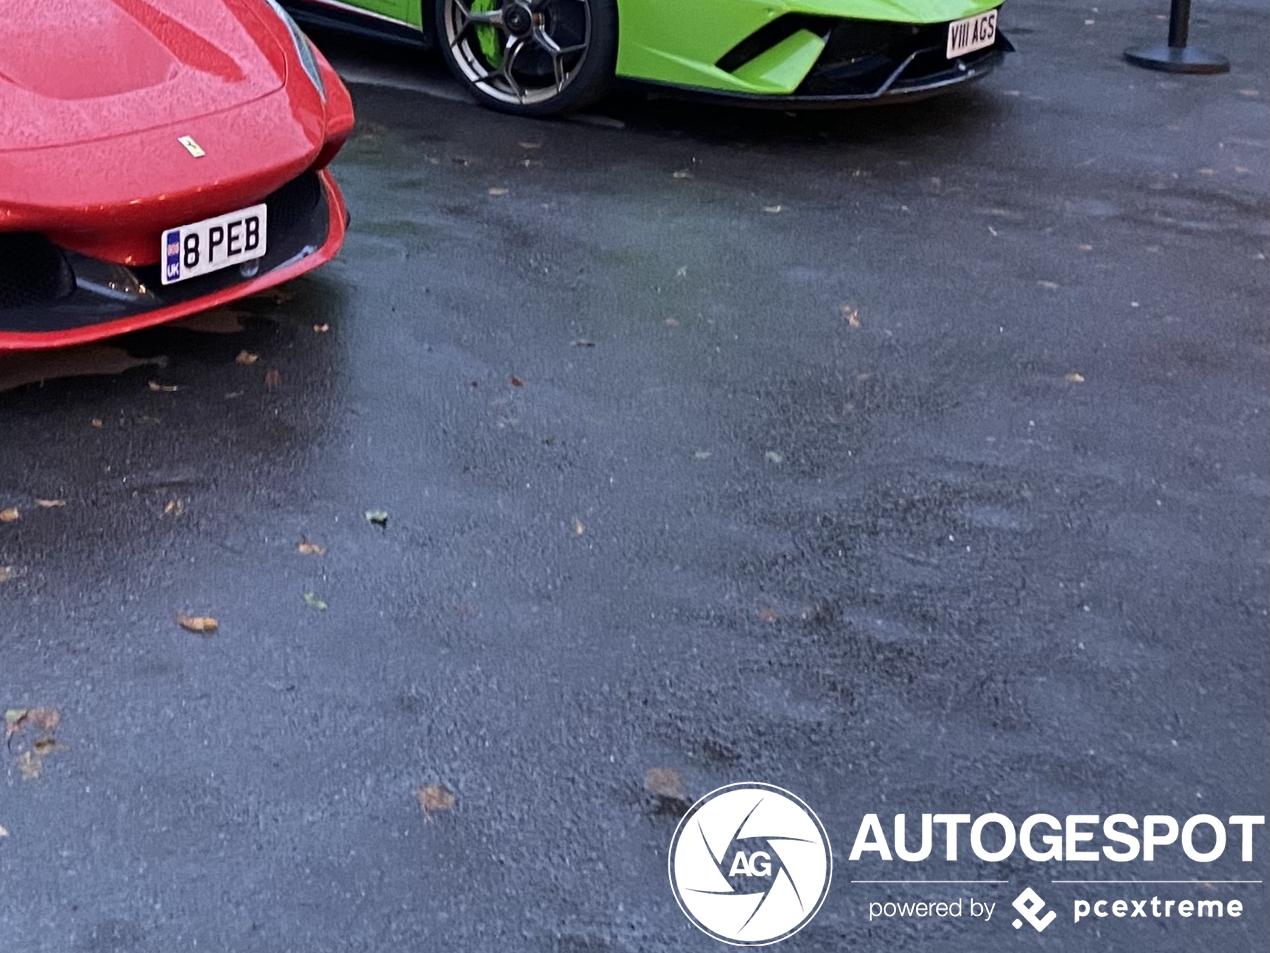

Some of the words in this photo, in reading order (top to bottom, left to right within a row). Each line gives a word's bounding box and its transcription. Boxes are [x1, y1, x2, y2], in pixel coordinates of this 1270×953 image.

[971, 14, 995, 45] AGS
[183, 233, 200, 269] 8
[208, 216, 260, 263] PEB
[166, 263, 180, 278] UK
